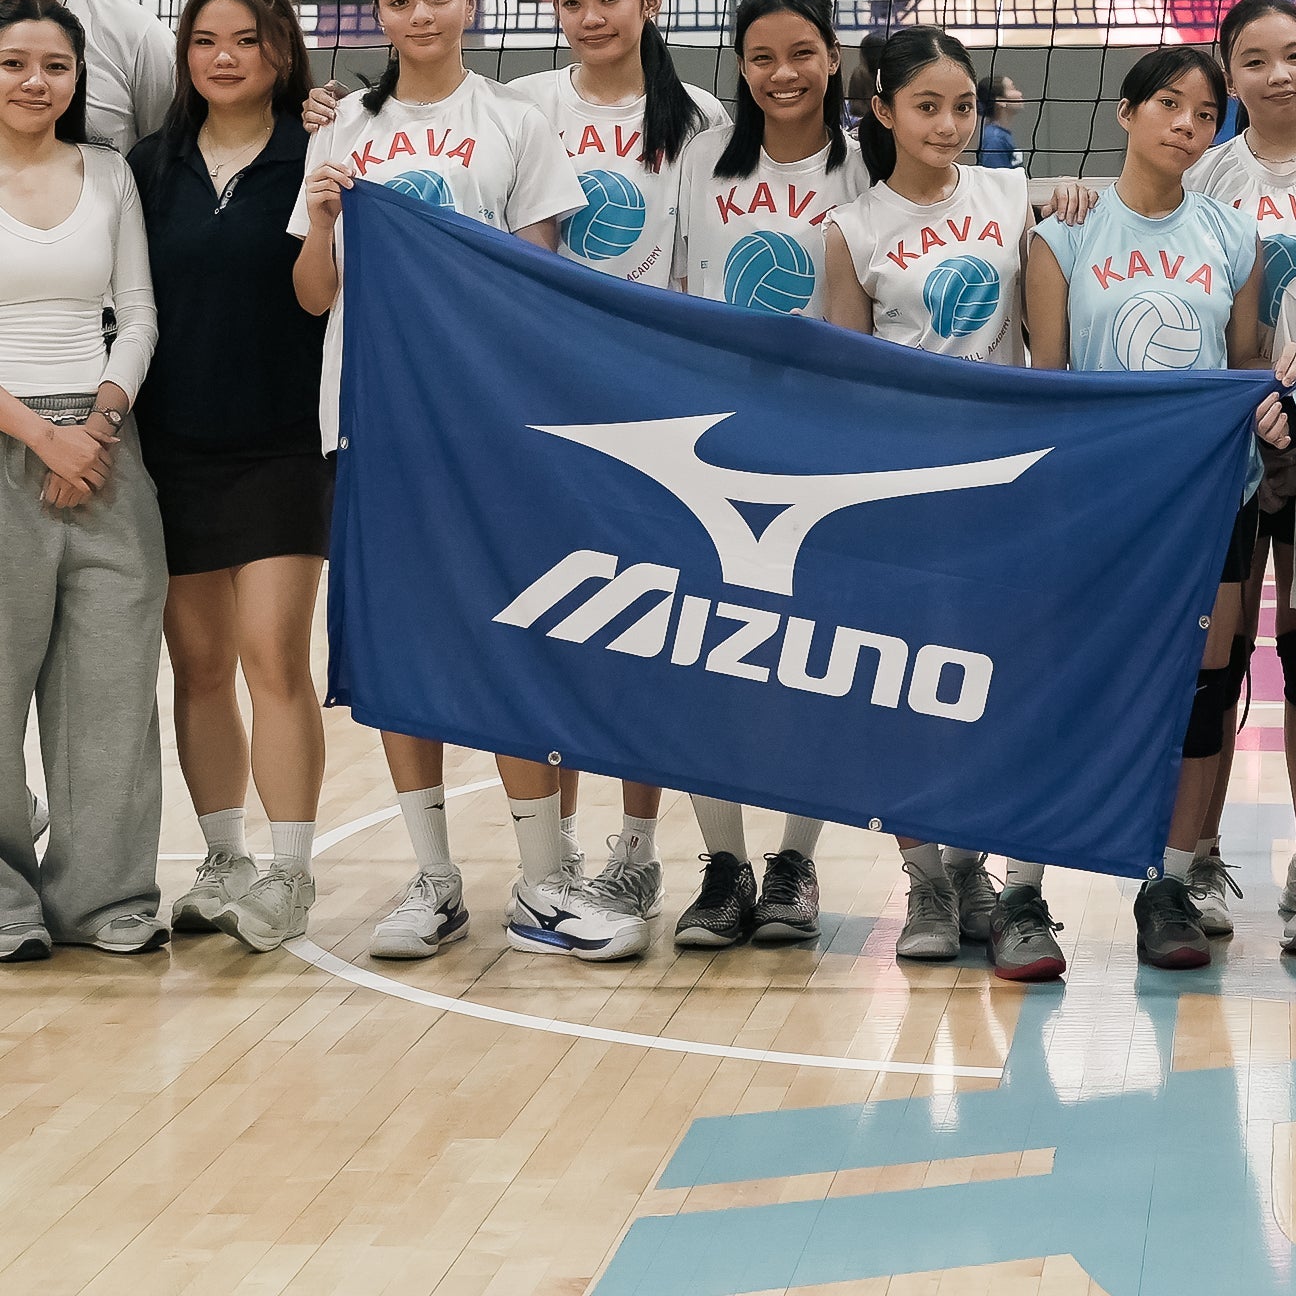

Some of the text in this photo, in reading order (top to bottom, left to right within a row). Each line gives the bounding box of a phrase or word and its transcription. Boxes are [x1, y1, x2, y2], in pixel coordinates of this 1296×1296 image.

[351, 128, 476, 175] KAVA
[626, 245, 663, 282] ACADEMY
[887, 216, 1004, 270] KAVA
[1091, 250, 1214, 295] KAVA
[987, 317, 1012, 355] ACADEMY
[491, 549, 994, 723] MIZUNO
